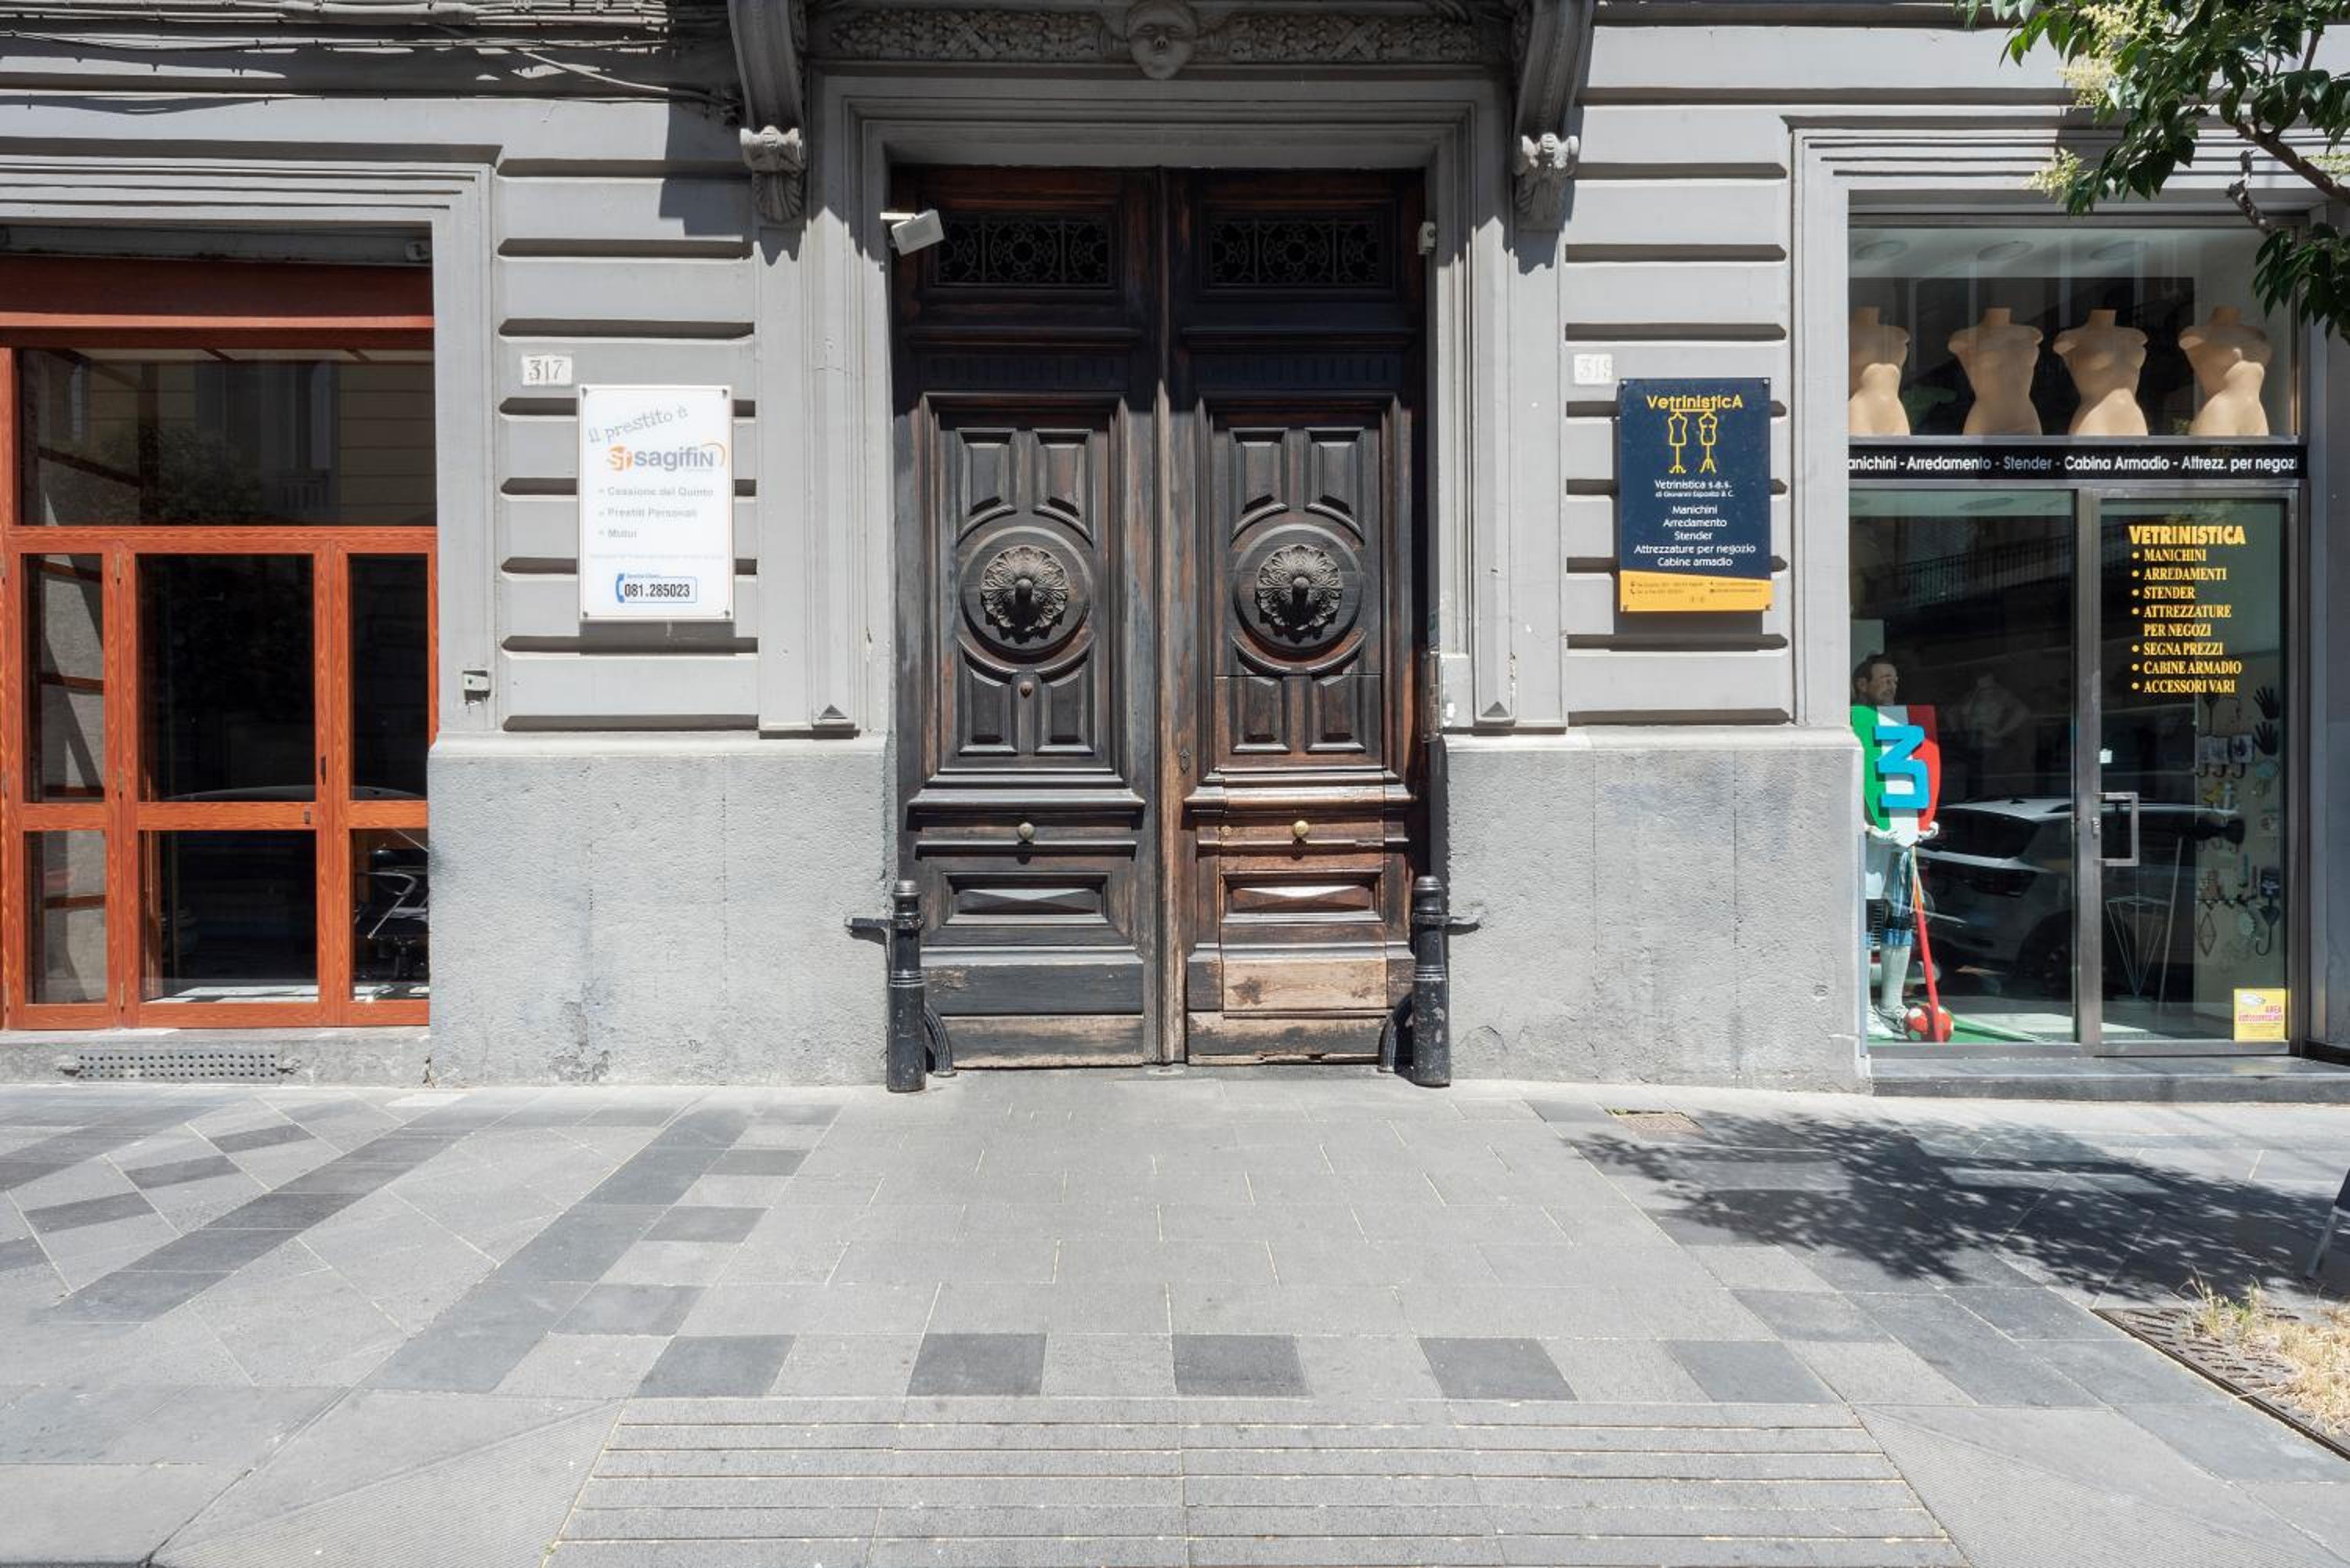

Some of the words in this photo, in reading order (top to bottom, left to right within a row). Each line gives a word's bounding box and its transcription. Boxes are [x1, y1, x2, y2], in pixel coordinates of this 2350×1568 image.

[529, 359, 565, 380] 317
[605, 408, 673, 443] prestito
[1907, 455, 1991, 471] Arredamento
[2003, 456, 2052, 471] Stender
[2064, 455, 2111, 471] Cabina
[2114, 455, 2170, 471] Armadio
[2182, 456, 2227, 471] Attrezz.
[2230, 457, 2253, 473] per
[1654, 479, 1706, 490] Vetrinistica
[678, 486, 714, 497] Quinto
[1672, 505, 1718, 515] Manichini
[1662, 518, 1728, 527] Arredamento
[1674, 530, 1713, 540] Stender
[2129, 526, 2246, 544] VETRINISTICA
[1633, 544, 1694, 554] Attrezzature
[1697, 546, 1714, 555] per
[1716, 544, 1756, 555] negozio
[2143, 549, 2207, 561] MANICHINI
[1657, 556, 1691, 566] Cabine
[1693, 557, 1734, 566] armadio
[2143, 568, 2227, 580] ARREDAMENTI
[624, 583, 690, 598] 081.285023
[2143, 586, 2196, 599] STENDER
[2143, 605, 2232, 618] ATTREZZATURE
[2143, 623, 2166, 637] PER
[2168, 623, 2211, 637] NEGOZI
[2143, 642, 2182, 656] SEGNA
[2183, 642, 2224, 656] PREZZI
[2143, 661, 2186, 674] CABINE
[2187, 661, 2243, 674] ARMADIO
[2143, 680, 2207, 693] ACCESSORI
[2209, 680, 2235, 693] VARI
